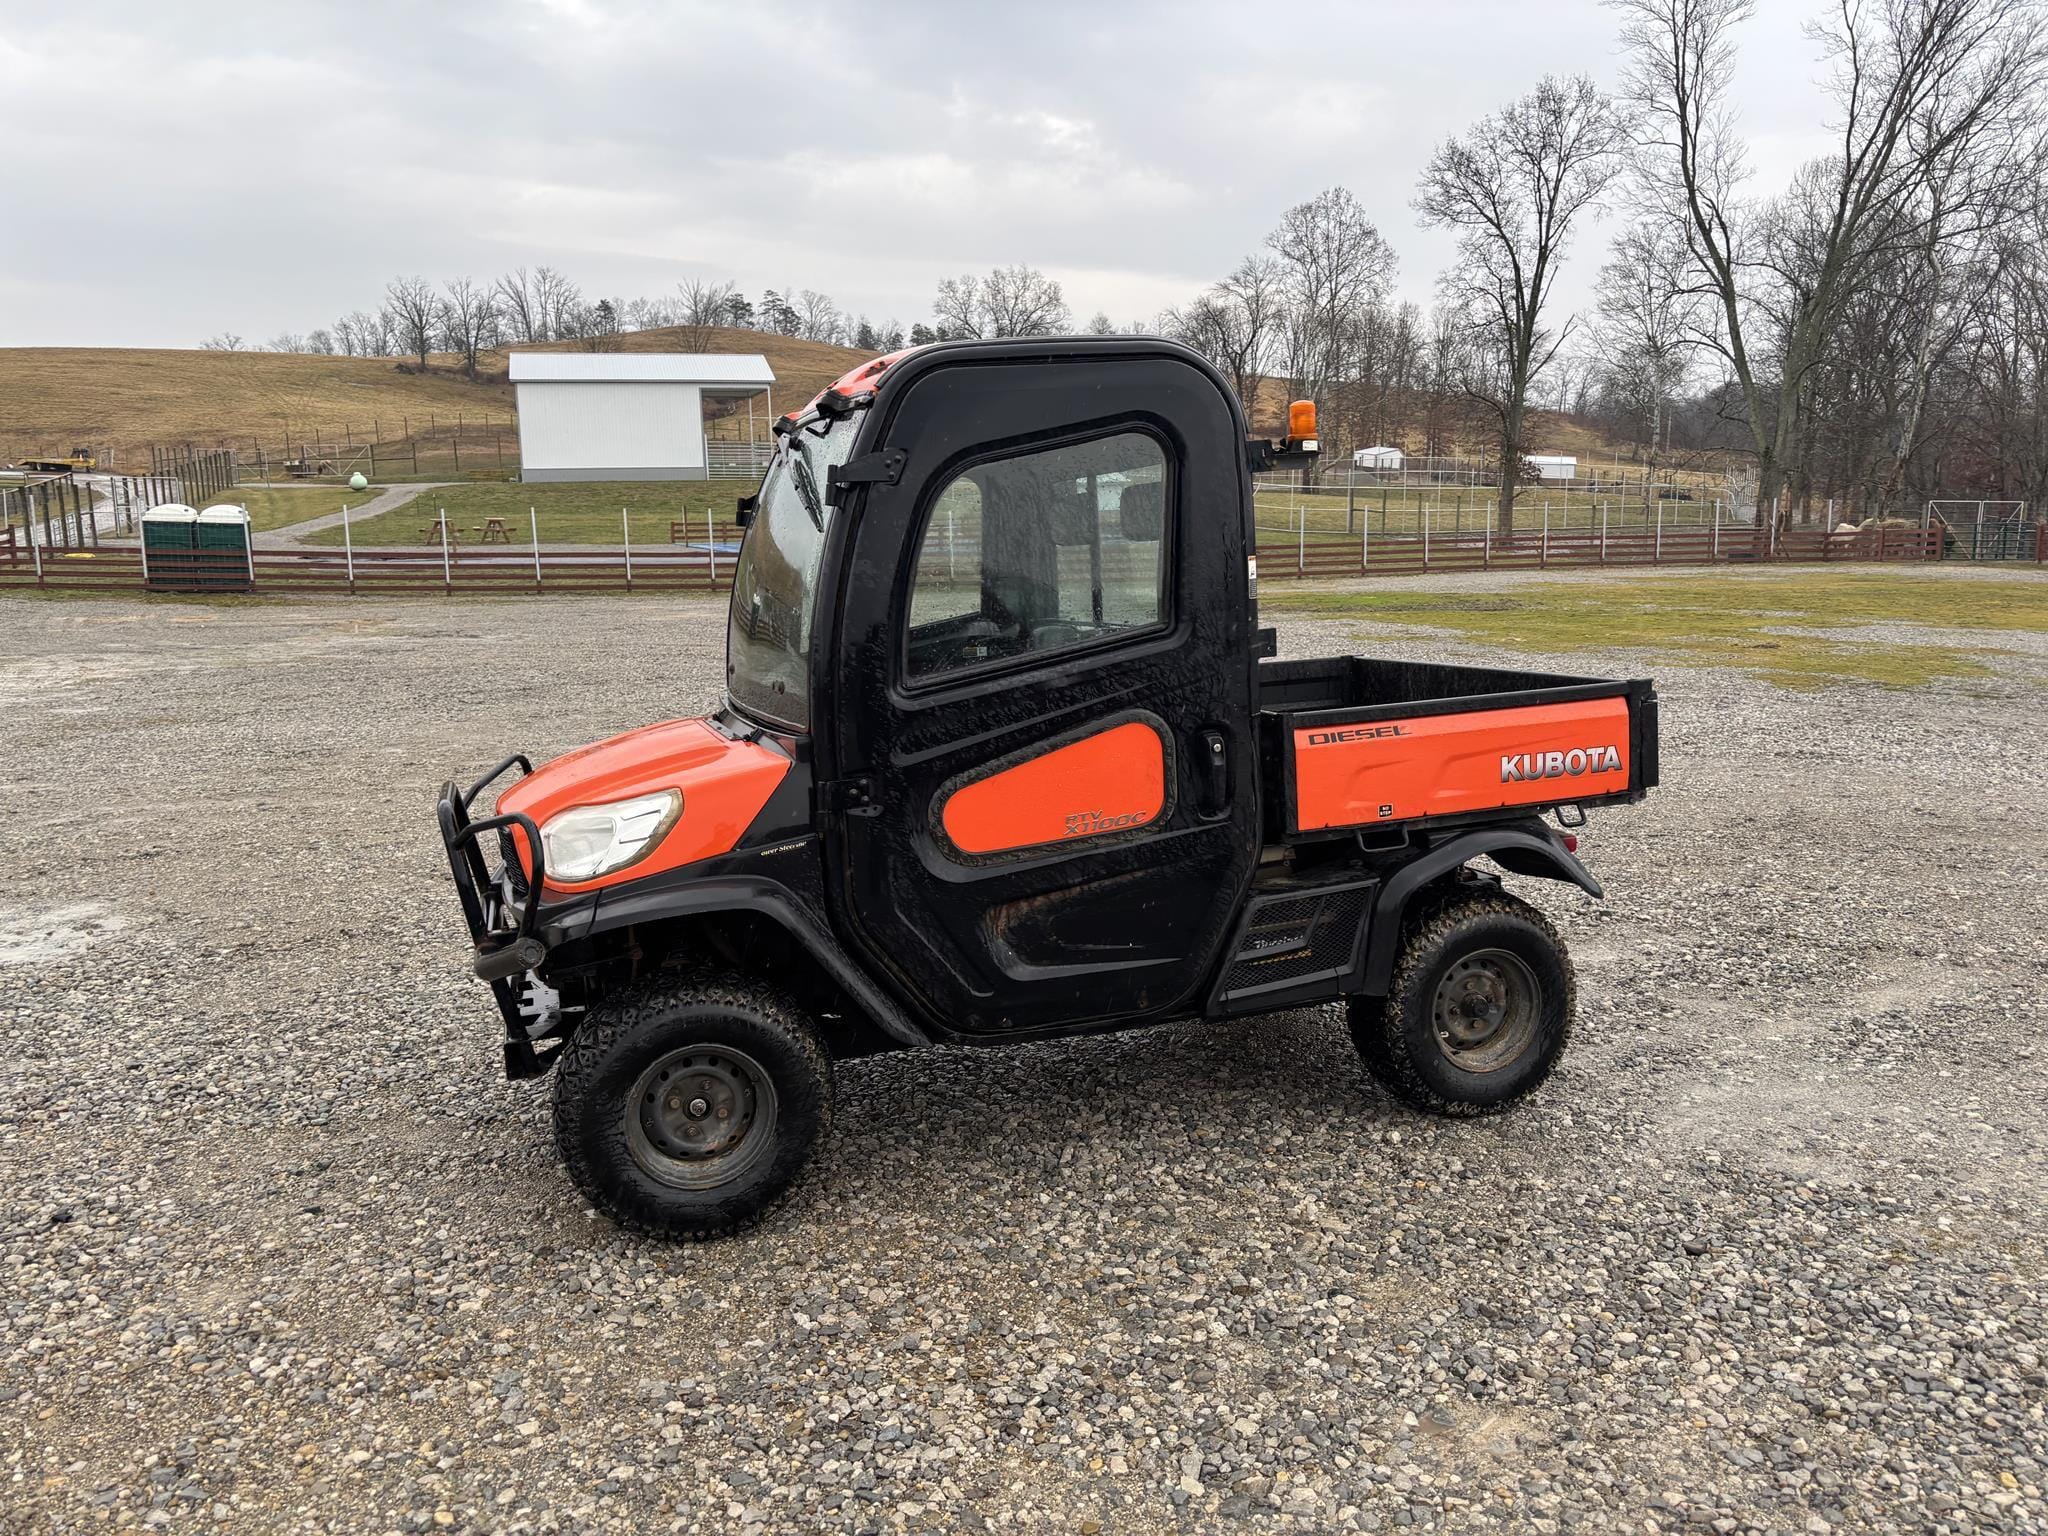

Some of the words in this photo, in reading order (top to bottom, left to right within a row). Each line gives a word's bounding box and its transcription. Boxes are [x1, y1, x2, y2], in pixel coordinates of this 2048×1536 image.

[1308, 725, 1413, 746] DIESEL
[1500, 744, 1623, 784] KUBOTA
[1064, 810, 1147, 835] X1100C
[1065, 810, 1103, 825] RTV
